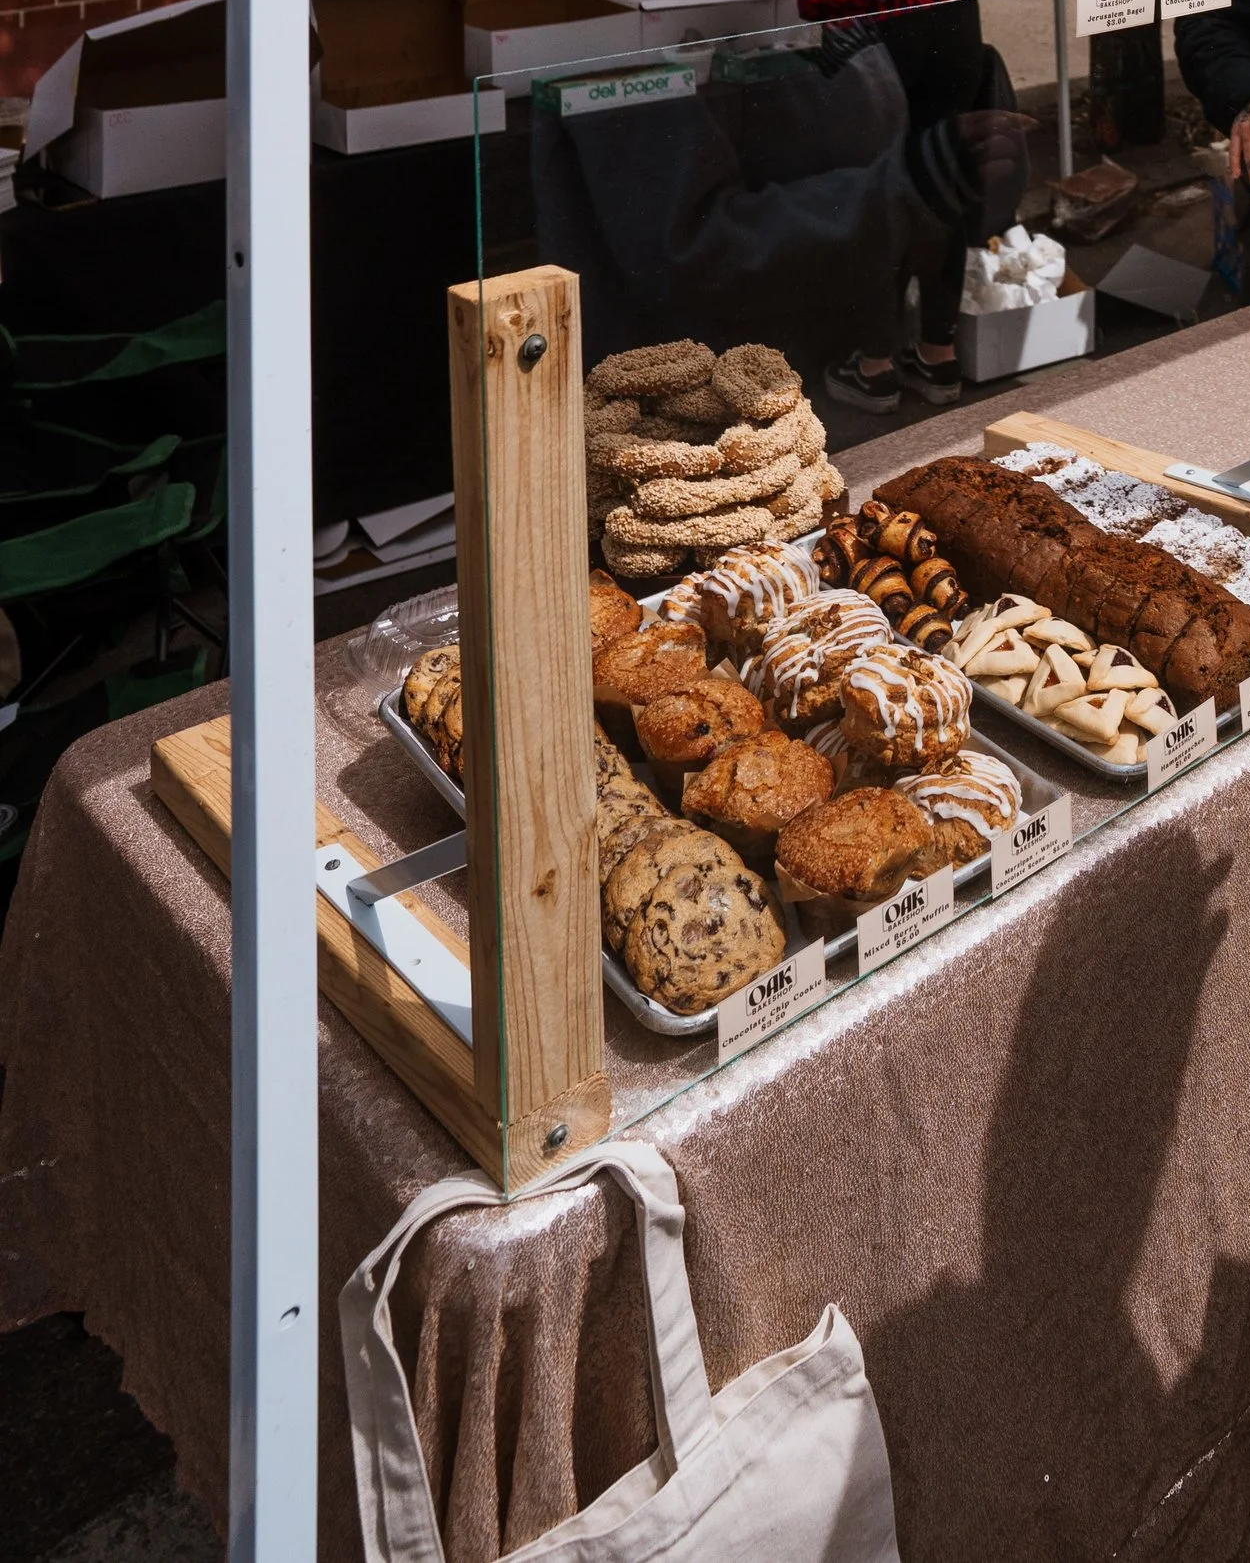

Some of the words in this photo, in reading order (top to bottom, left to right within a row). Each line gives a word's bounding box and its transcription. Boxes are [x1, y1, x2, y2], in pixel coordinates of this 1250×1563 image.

[1088, 11, 1124, 22] Jerusalem
[1127, 7, 1145, 16] Bagel
[1188, 1, 1205, 9] $1.00
[1107, 17, 1127, 27] $3.00
[589, 82, 616, 100] deli
[623, 77, 670, 98] paper
[1165, 718, 1194, 748] OAK
[1168, 733, 1195, 755] BAKESHOP
[1160, 737, 1205, 772] Hamantaschen
[1175, 753, 1191, 768] $1.00
[1013, 815, 1046, 848] OAK
[1015, 832, 1047, 856] BAKESHOP
[1004, 855, 1033, 876] Marzipan
[1040, 839, 1058, 853] White
[995, 869, 1026, 890] Chocolate
[1027, 856, 1045, 870] Scone
[884, 887, 925, 924] OAK
[887, 906, 925, 932] BAKESHOP
[863, 938, 890, 959] Mixed
[894, 921, 919, 941] Berry
[921, 902, 950, 925] Muffin
[748, 965, 793, 1007] OAK
[752, 984, 793, 1016] BAKESHOP
[722, 1015, 766, 1048] Chocolate
[770, 1000, 790, 1016] Chip
[793, 979, 822, 1001] Cookie
[761, 1011, 786, 1032] $3.50
